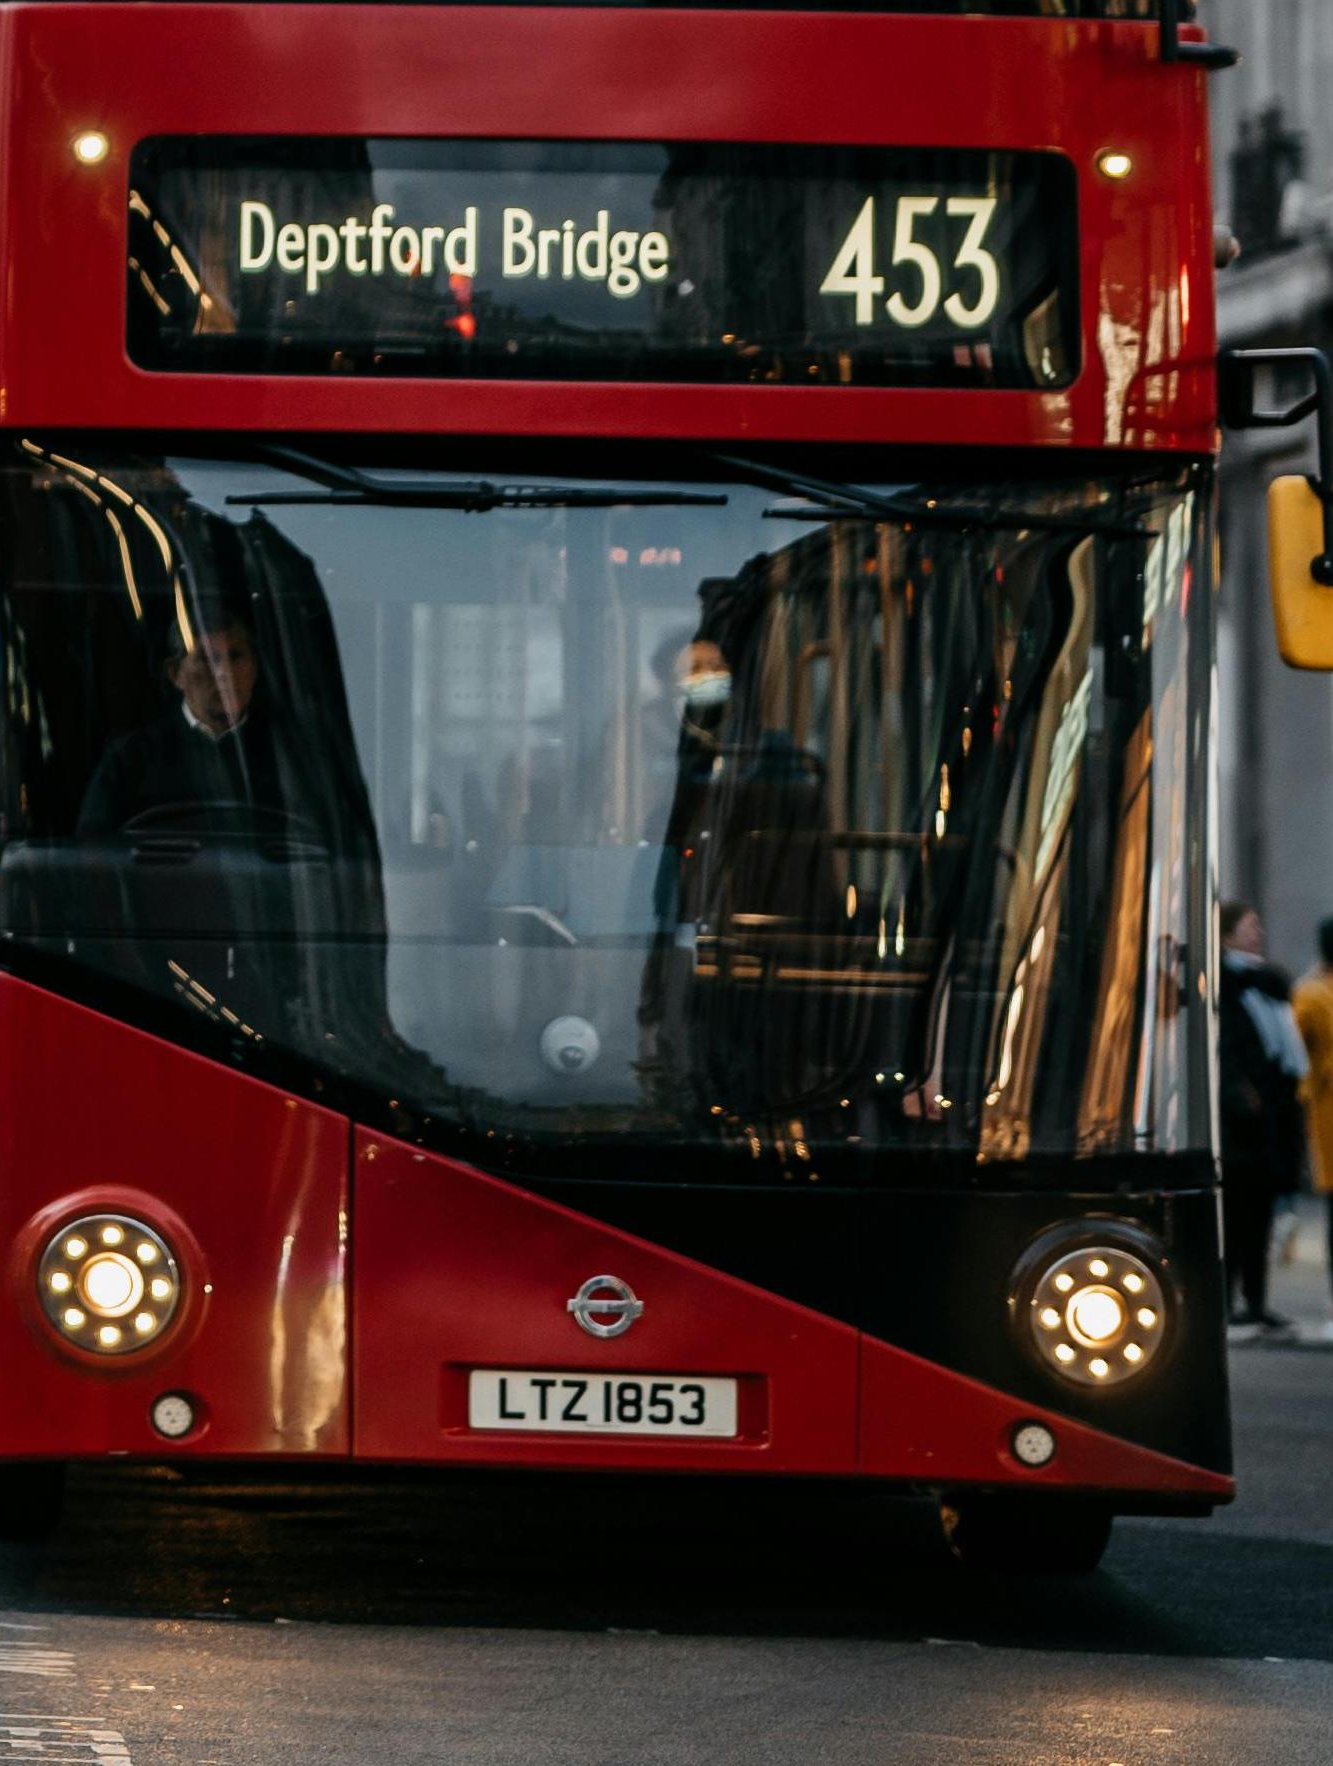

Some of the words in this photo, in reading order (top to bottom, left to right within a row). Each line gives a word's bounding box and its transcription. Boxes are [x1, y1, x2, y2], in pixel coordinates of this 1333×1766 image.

[239, 202, 478, 293] Deptford
[502, 208, 669, 298] Bridge
[819, 197, 1001, 328] 453
[499, 1378, 588, 1421] LTZ
[603, 1381, 706, 1425] 1853
